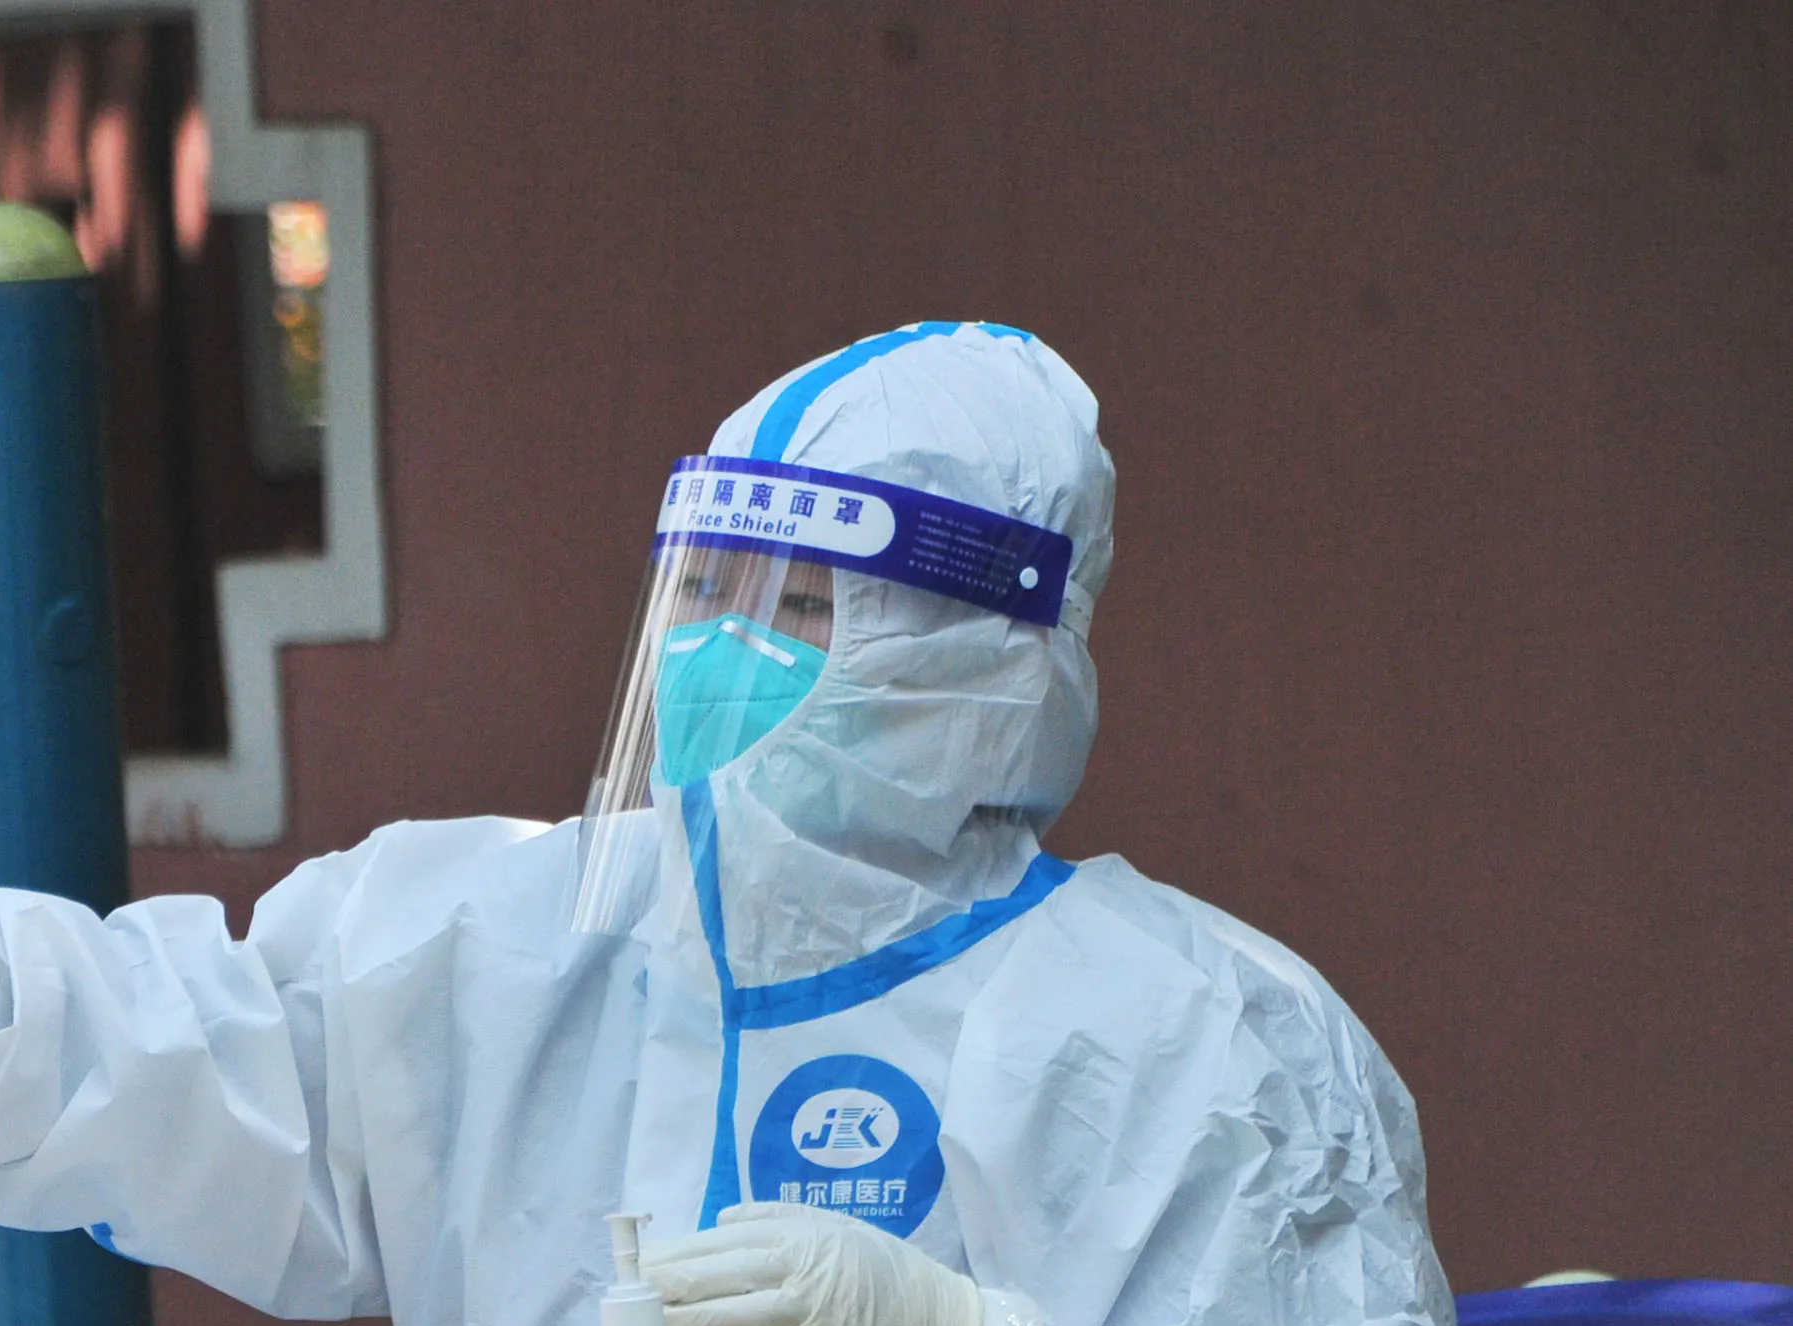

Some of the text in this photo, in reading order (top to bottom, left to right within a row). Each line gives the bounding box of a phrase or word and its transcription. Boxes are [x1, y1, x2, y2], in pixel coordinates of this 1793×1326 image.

[667, 478, 865, 525] 医用隔离面罩
[688, 509, 798, 538] Face Shield
[779, 1179, 907, 1207] 健尔康医疗
[852, 1206, 905, 1217] MEDICAL
